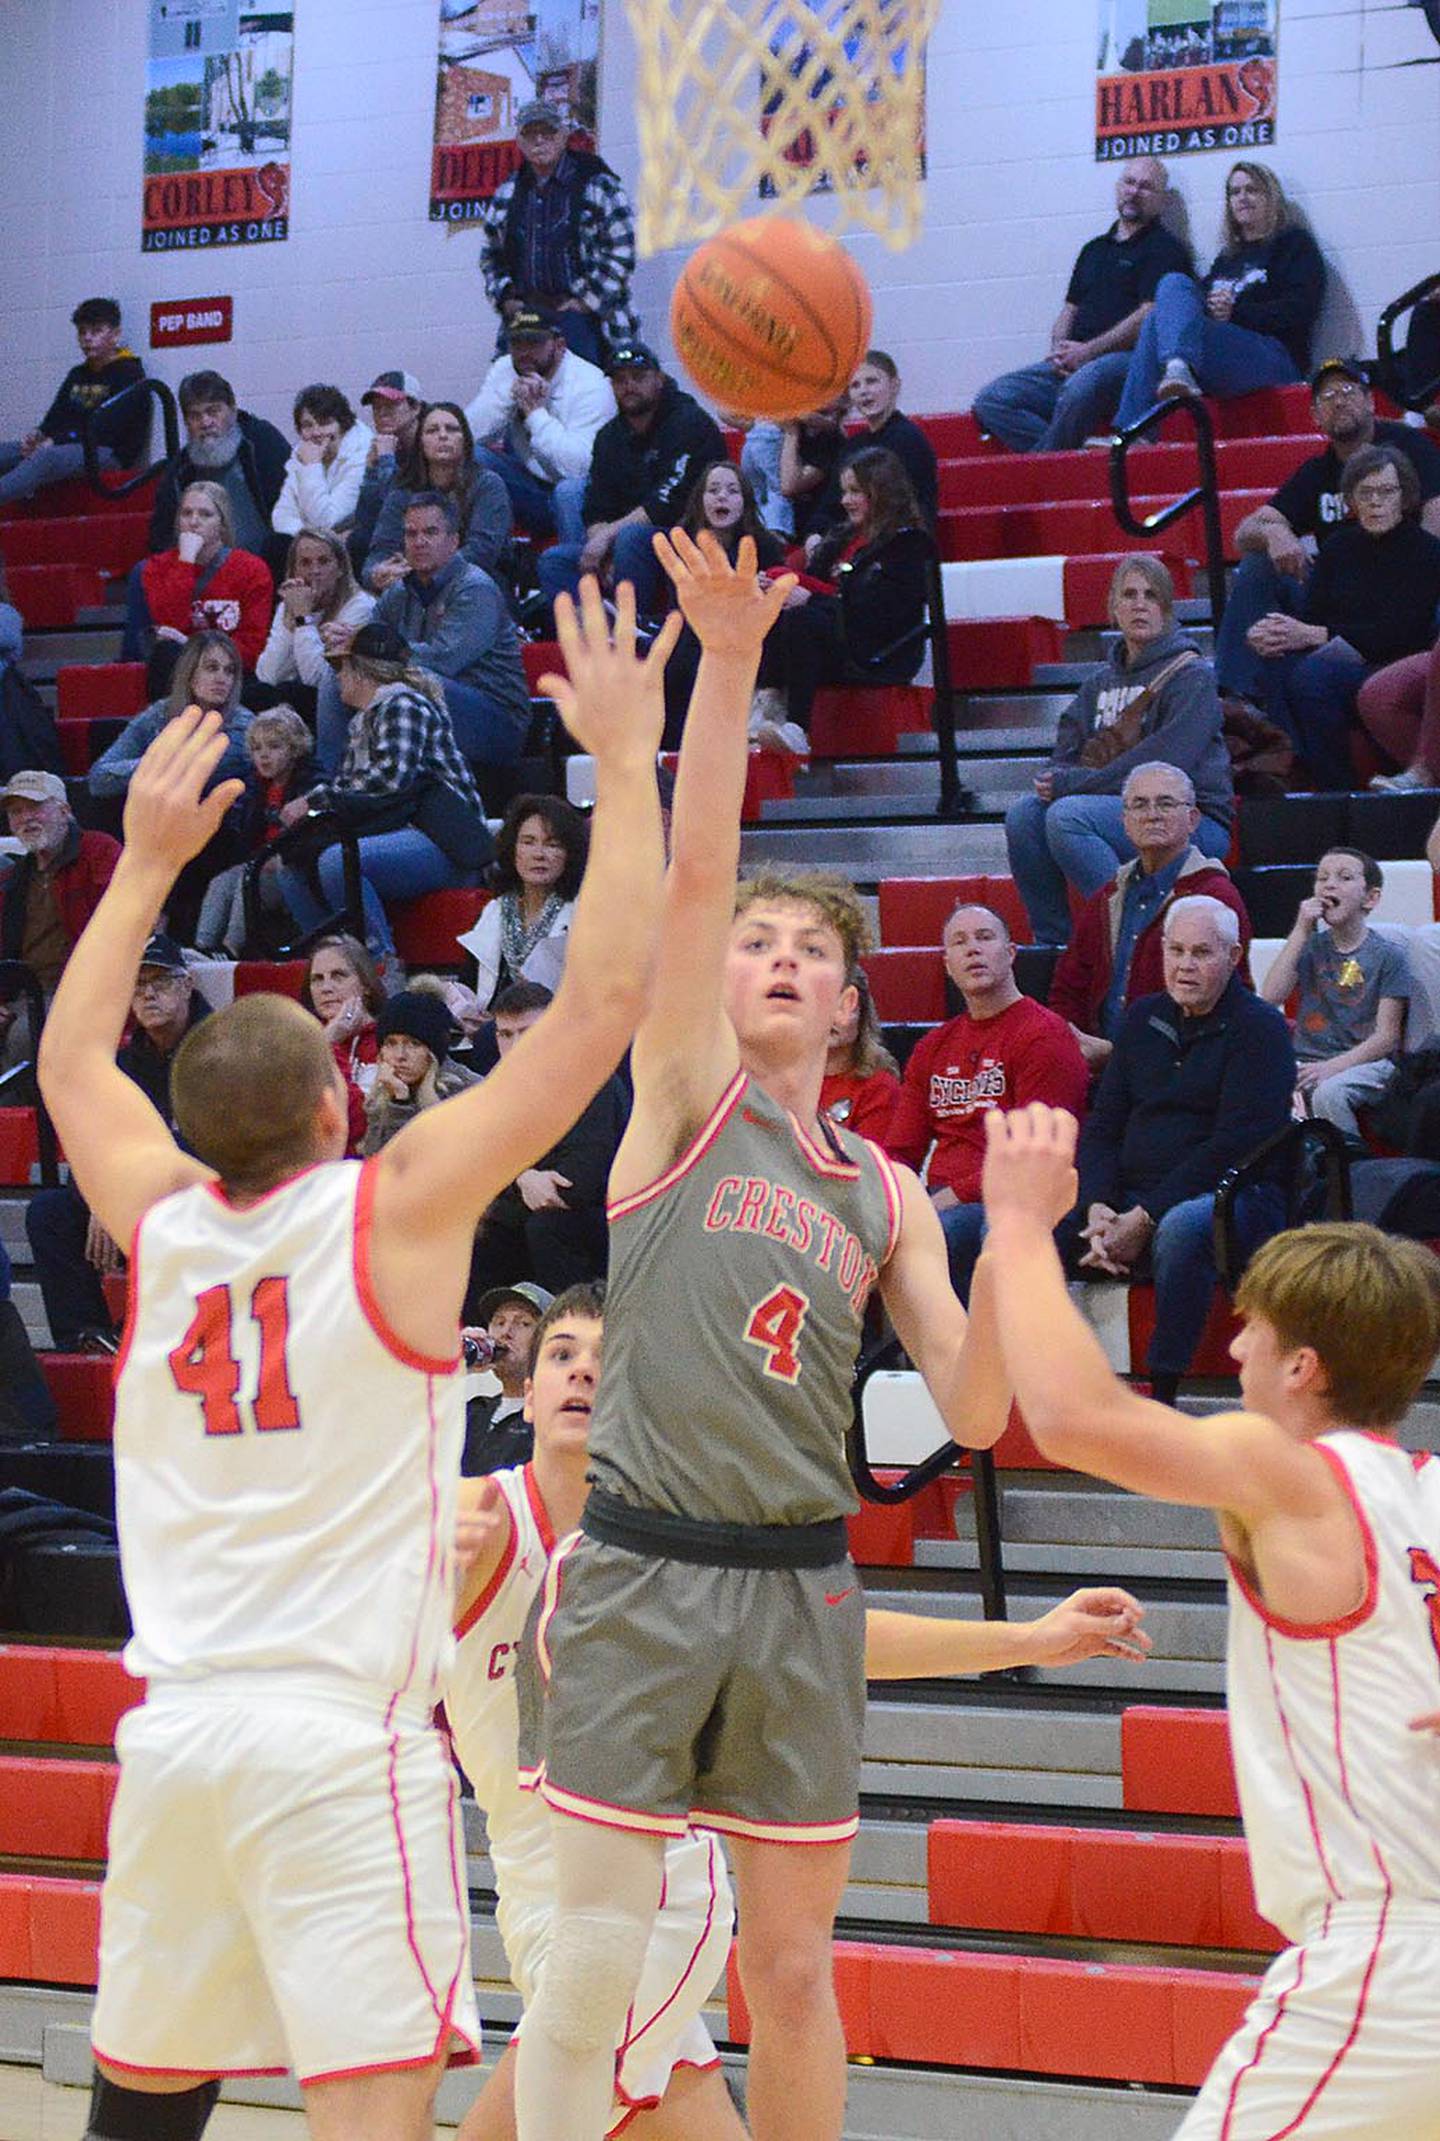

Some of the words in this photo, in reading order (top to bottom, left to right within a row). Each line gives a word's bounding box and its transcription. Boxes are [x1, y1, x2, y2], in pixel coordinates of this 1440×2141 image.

[1100, 73, 1241, 127] HARLAN
[1102, 133, 1181, 158] JOINED
[1187, 129, 1217, 149] AS
[1224, 123, 1272, 145] ONE
[144, 174, 256, 221] CORLEY
[432, 201, 488, 221] JOIN
[147, 226, 211, 249] JOINED
[217, 224, 241, 242] AS
[247, 220, 284, 240] ONE
[159, 314, 184, 333] PEP
[187, 310, 223, 331] BAND
[743, 1282, 810, 1386] 4
[168, 1274, 302, 1436] 41
